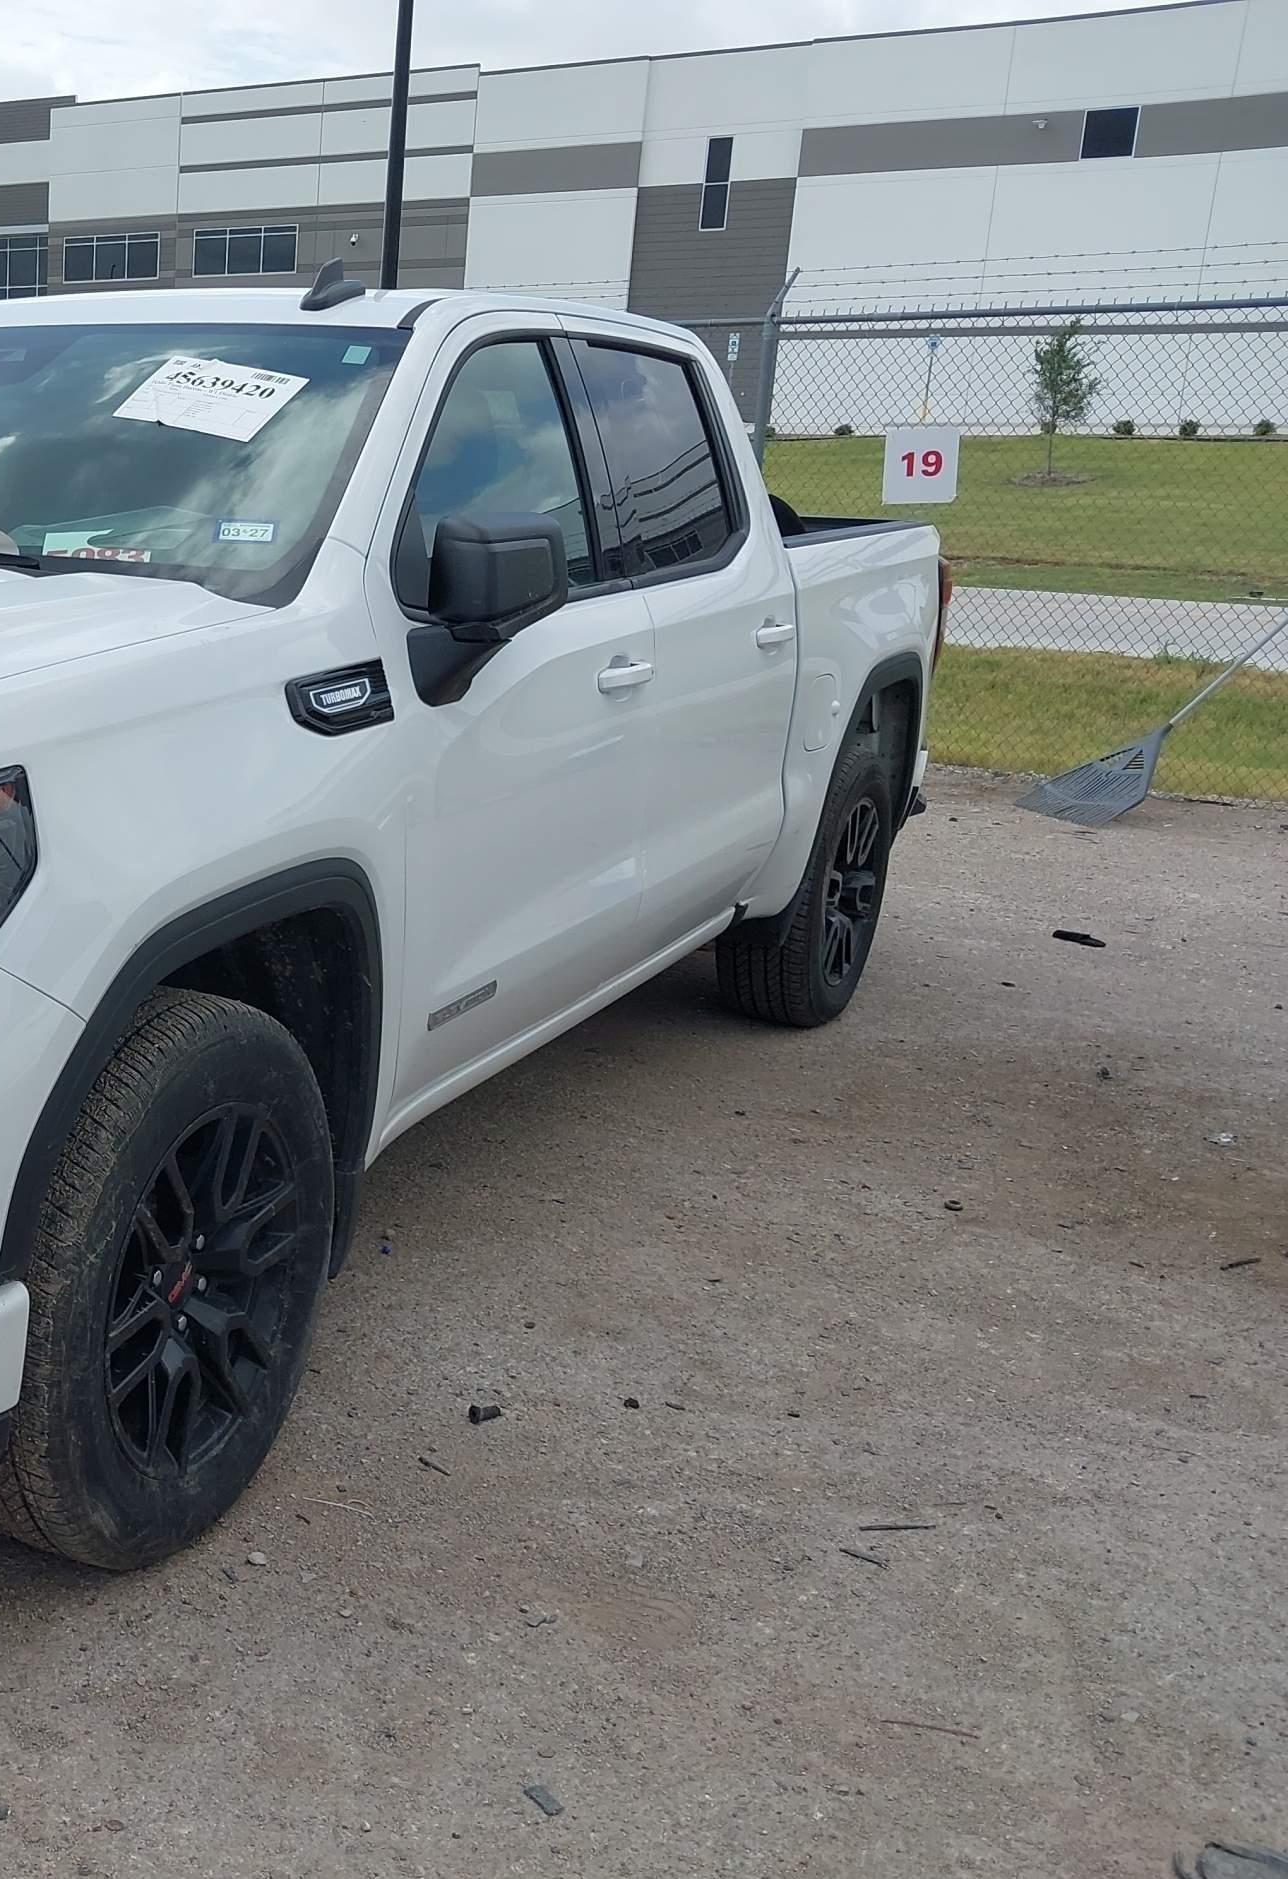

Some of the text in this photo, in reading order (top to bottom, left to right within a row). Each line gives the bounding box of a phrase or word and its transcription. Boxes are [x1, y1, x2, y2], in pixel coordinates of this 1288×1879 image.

[165, 370, 277, 399] 45639420
[901, 450, 943, 477] 19
[320, 685, 362, 706] TURBOMAX
